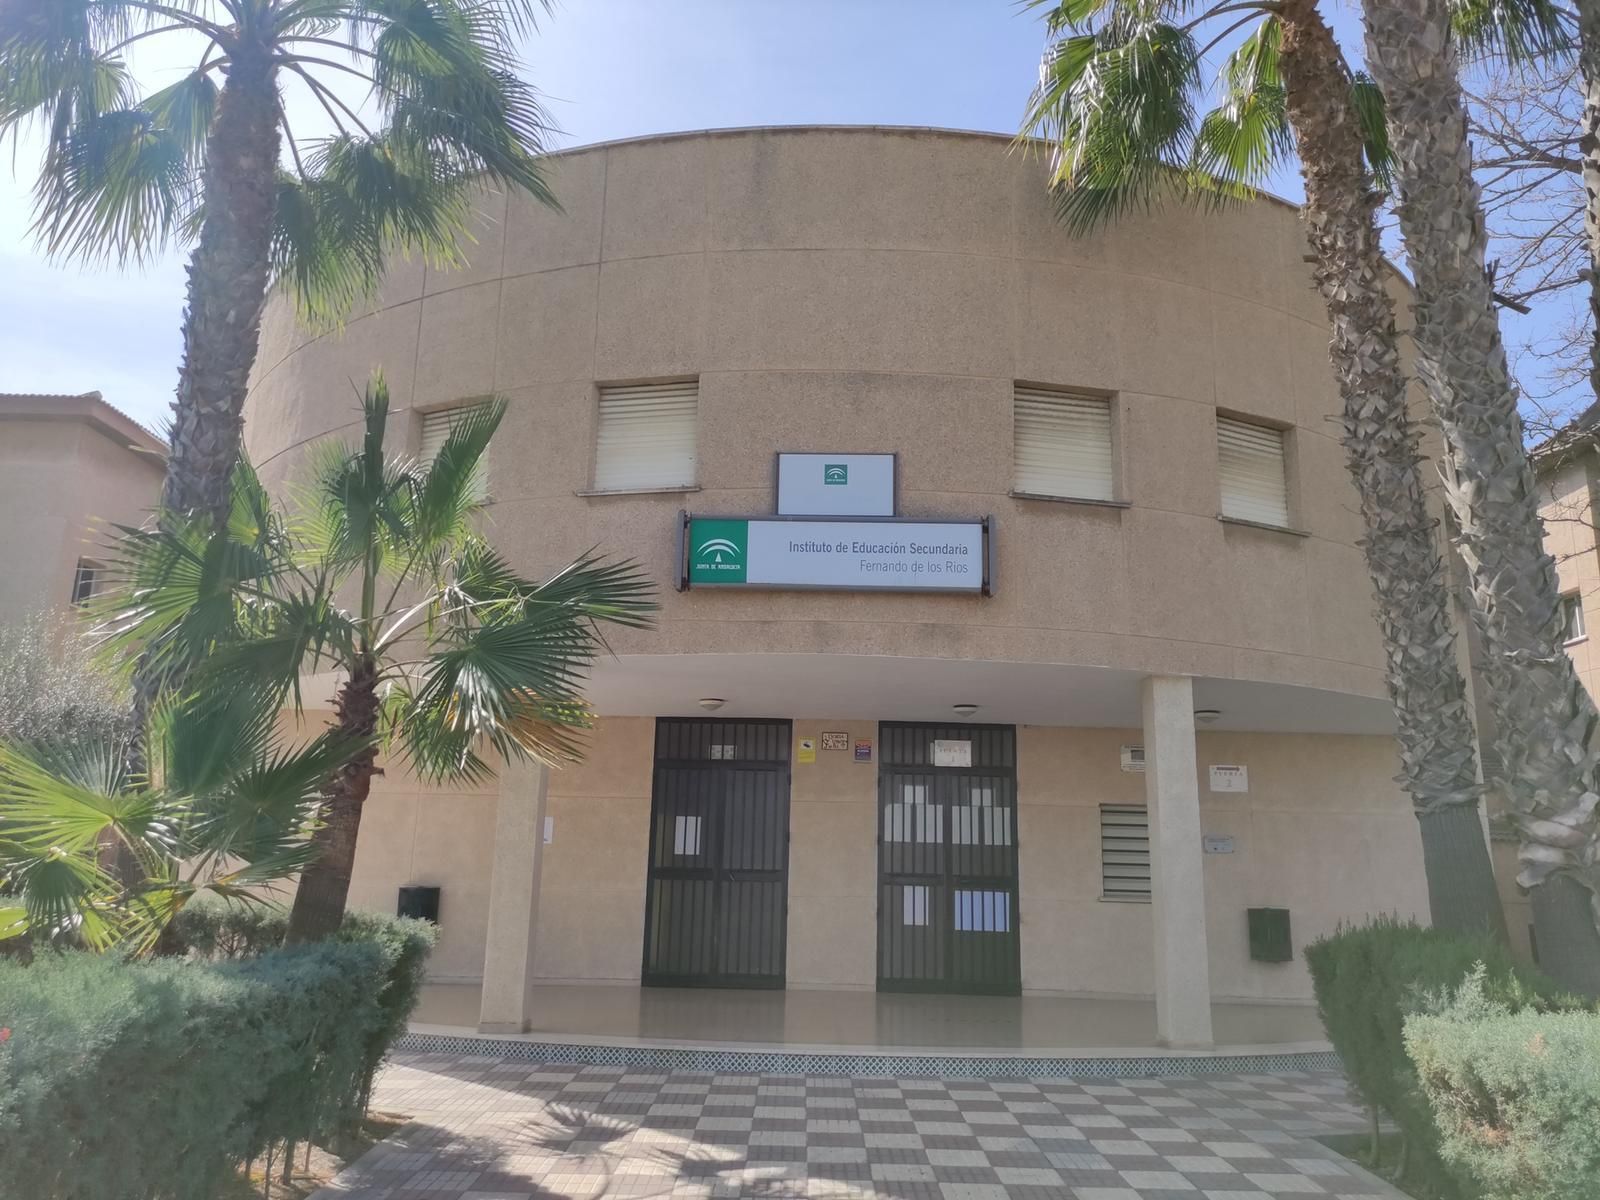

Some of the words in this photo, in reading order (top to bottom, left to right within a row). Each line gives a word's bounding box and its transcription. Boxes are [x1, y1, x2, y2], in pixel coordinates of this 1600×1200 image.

[789, 540, 832, 553] Instituto
[835, 541, 849, 553] de
[852, 541, 906, 554] Educación
[909, 542, 968, 555] Secundaria
[860, 559, 908, 573] Fernando
[910, 560, 924, 573] de
[927, 561, 942, 573] los
